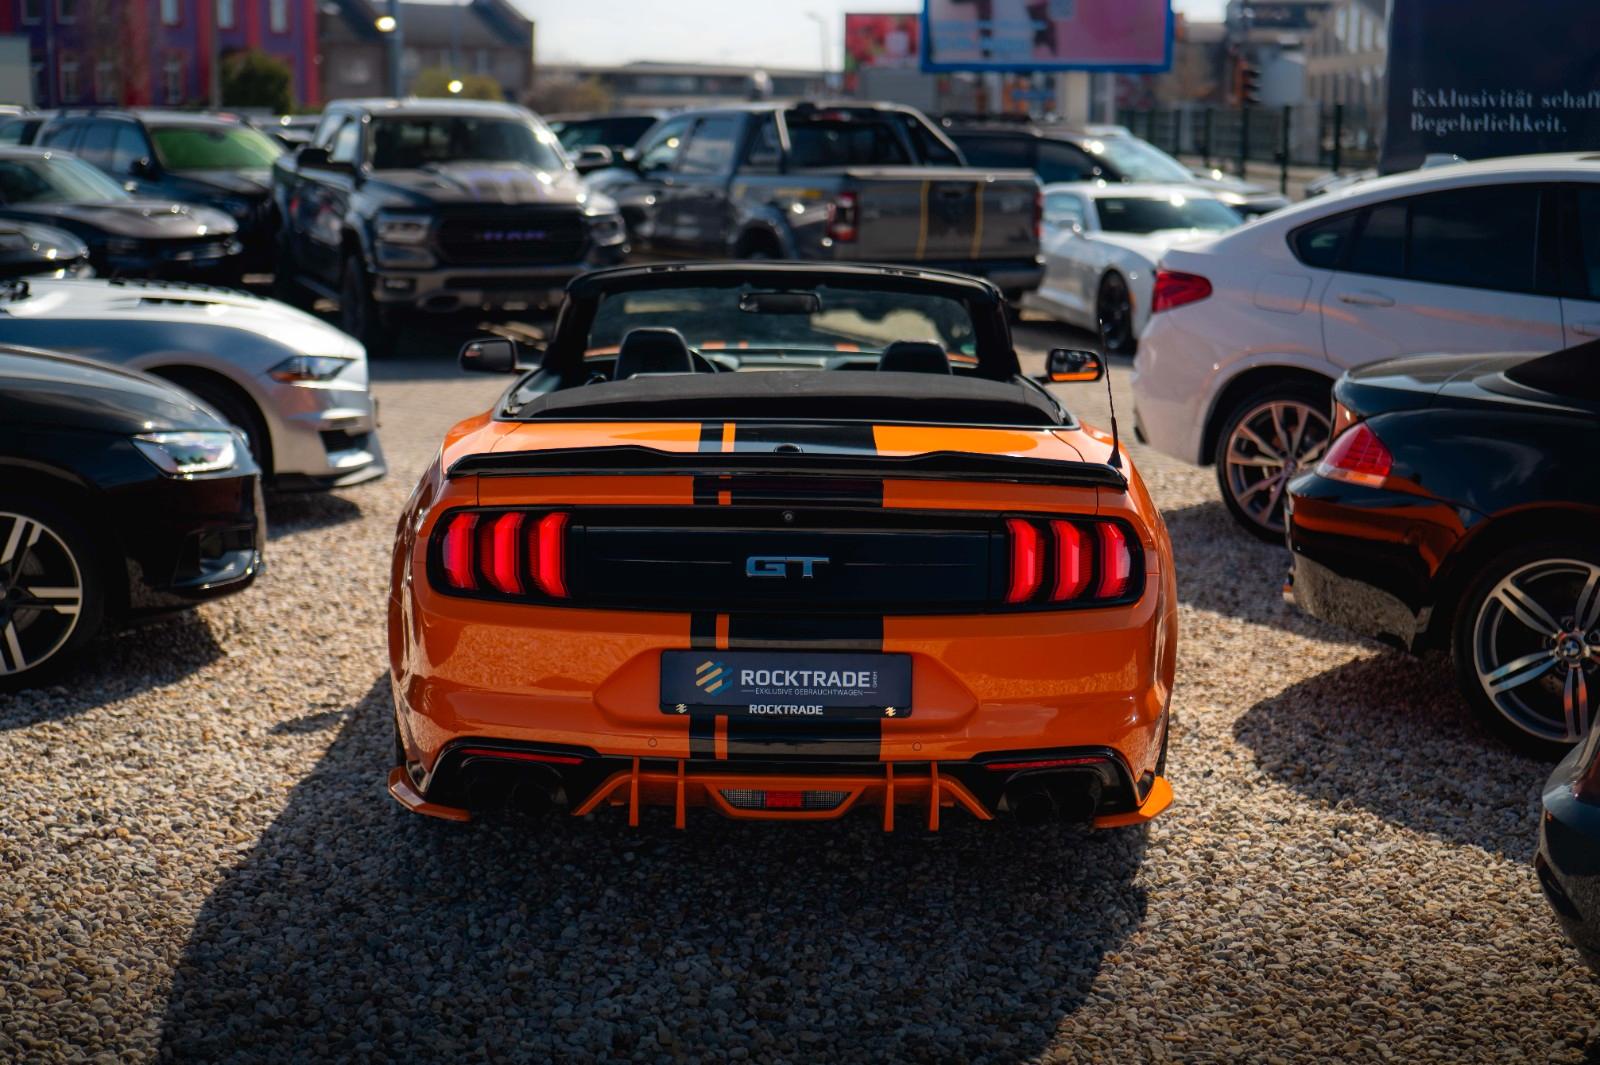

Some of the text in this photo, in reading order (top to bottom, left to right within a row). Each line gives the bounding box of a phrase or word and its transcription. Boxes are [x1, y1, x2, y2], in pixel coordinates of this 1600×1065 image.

[1411, 87, 1533, 108] Exklusivität
[1410, 111, 1568, 137] Begehrlichkeit.
[746, 556, 830, 577] GT
[740, 669, 871, 687] ROCKTRADE
[755, 687, 864, 697] EXKLUSIVE GEBRAUCHTWAGEN
[749, 704, 824, 715] ROCKTRADE
